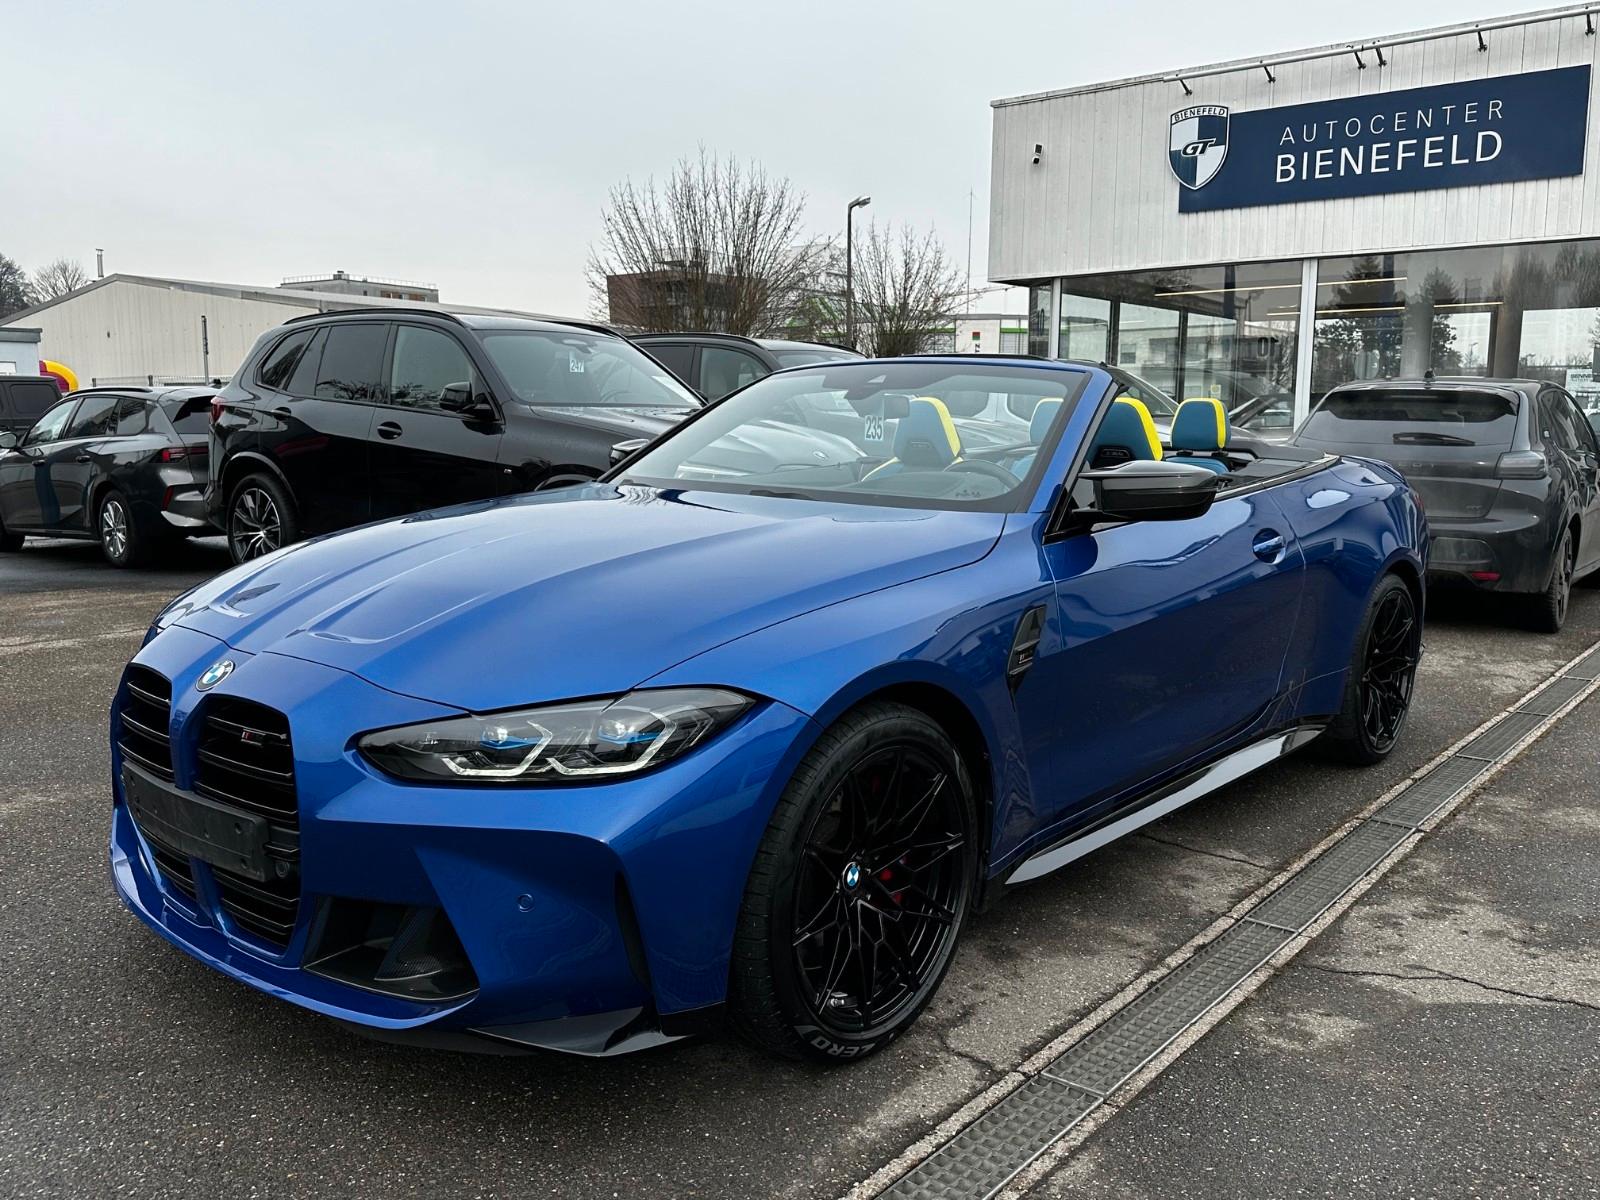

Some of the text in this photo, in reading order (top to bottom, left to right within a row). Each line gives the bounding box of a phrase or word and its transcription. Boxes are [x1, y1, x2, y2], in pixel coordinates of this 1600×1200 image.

[1174, 107, 1225, 122] BIENEFELD
[1280, 100, 1503, 145] AUTOCENTER
[1181, 138, 1216, 157] GT
[1276, 130, 1502, 183] BIENEFELD
[865, 416, 883, 439] 235
[811, 1036, 876, 1058] ZERO
